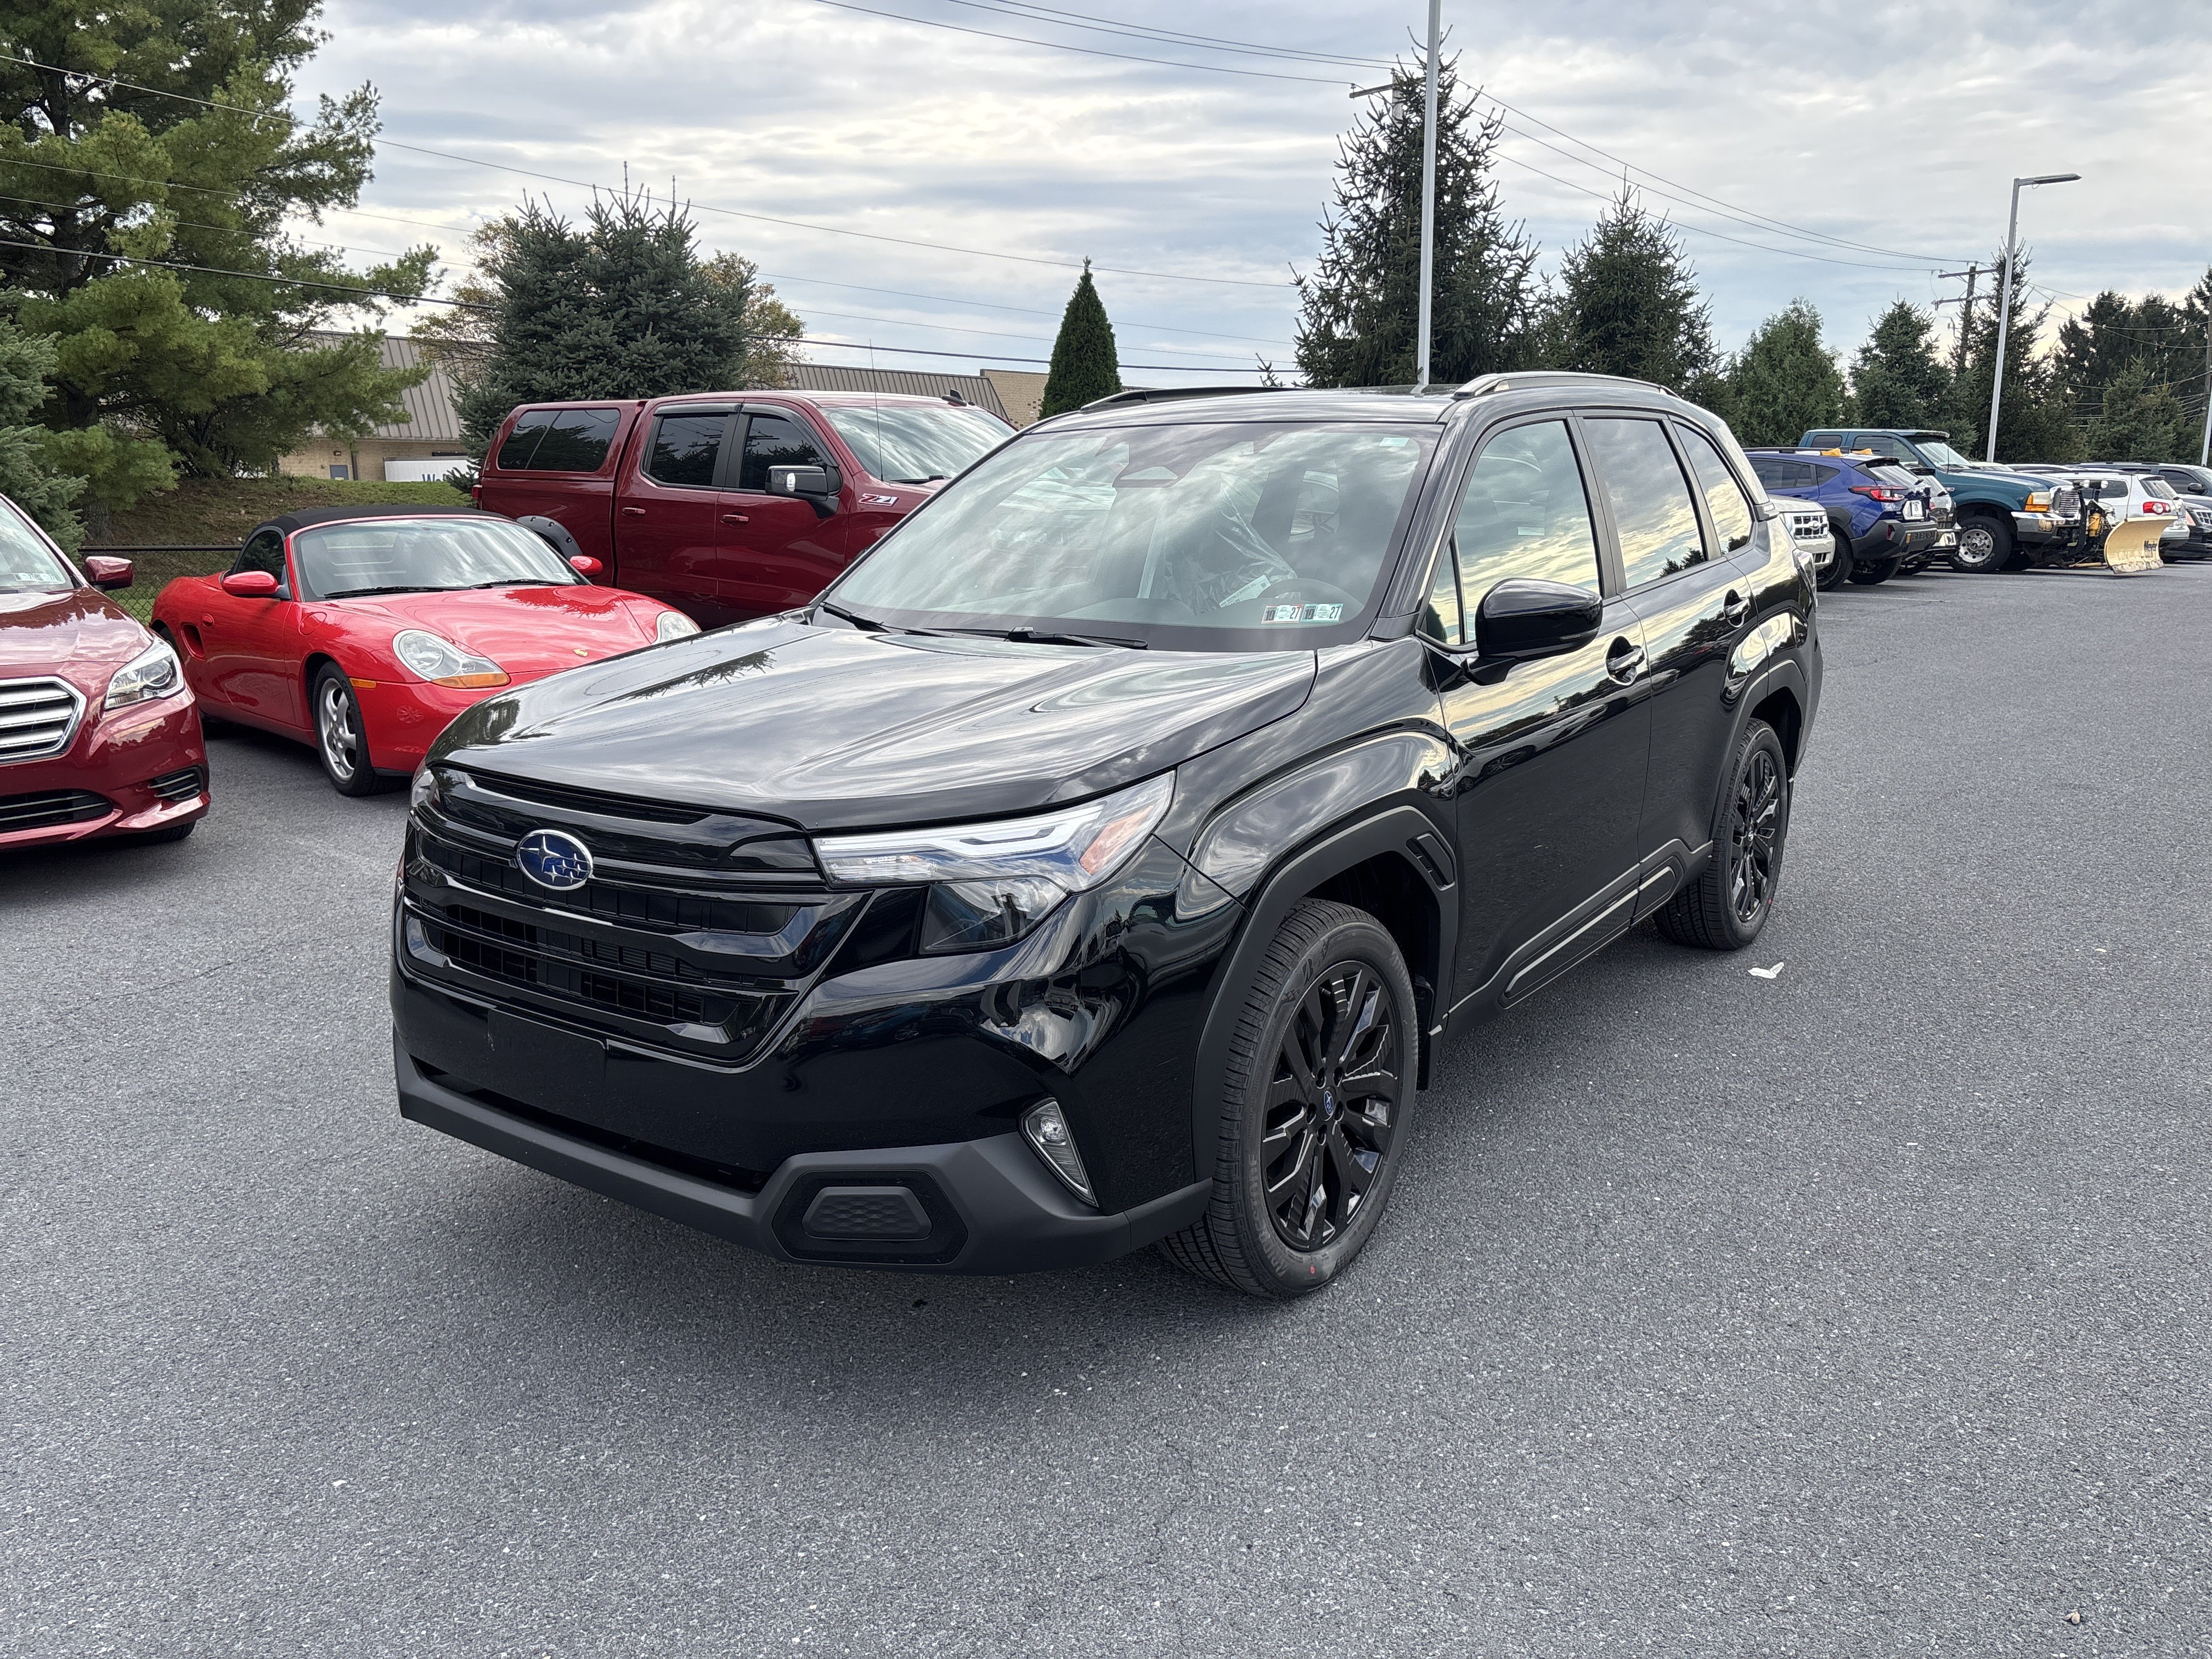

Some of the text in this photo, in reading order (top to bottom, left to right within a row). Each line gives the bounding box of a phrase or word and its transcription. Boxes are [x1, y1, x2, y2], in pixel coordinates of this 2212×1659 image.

[858, 493, 899, 507] Z71
[1289, 607, 1301, 619] 27
[1305, 606, 1340, 619] 10 27
